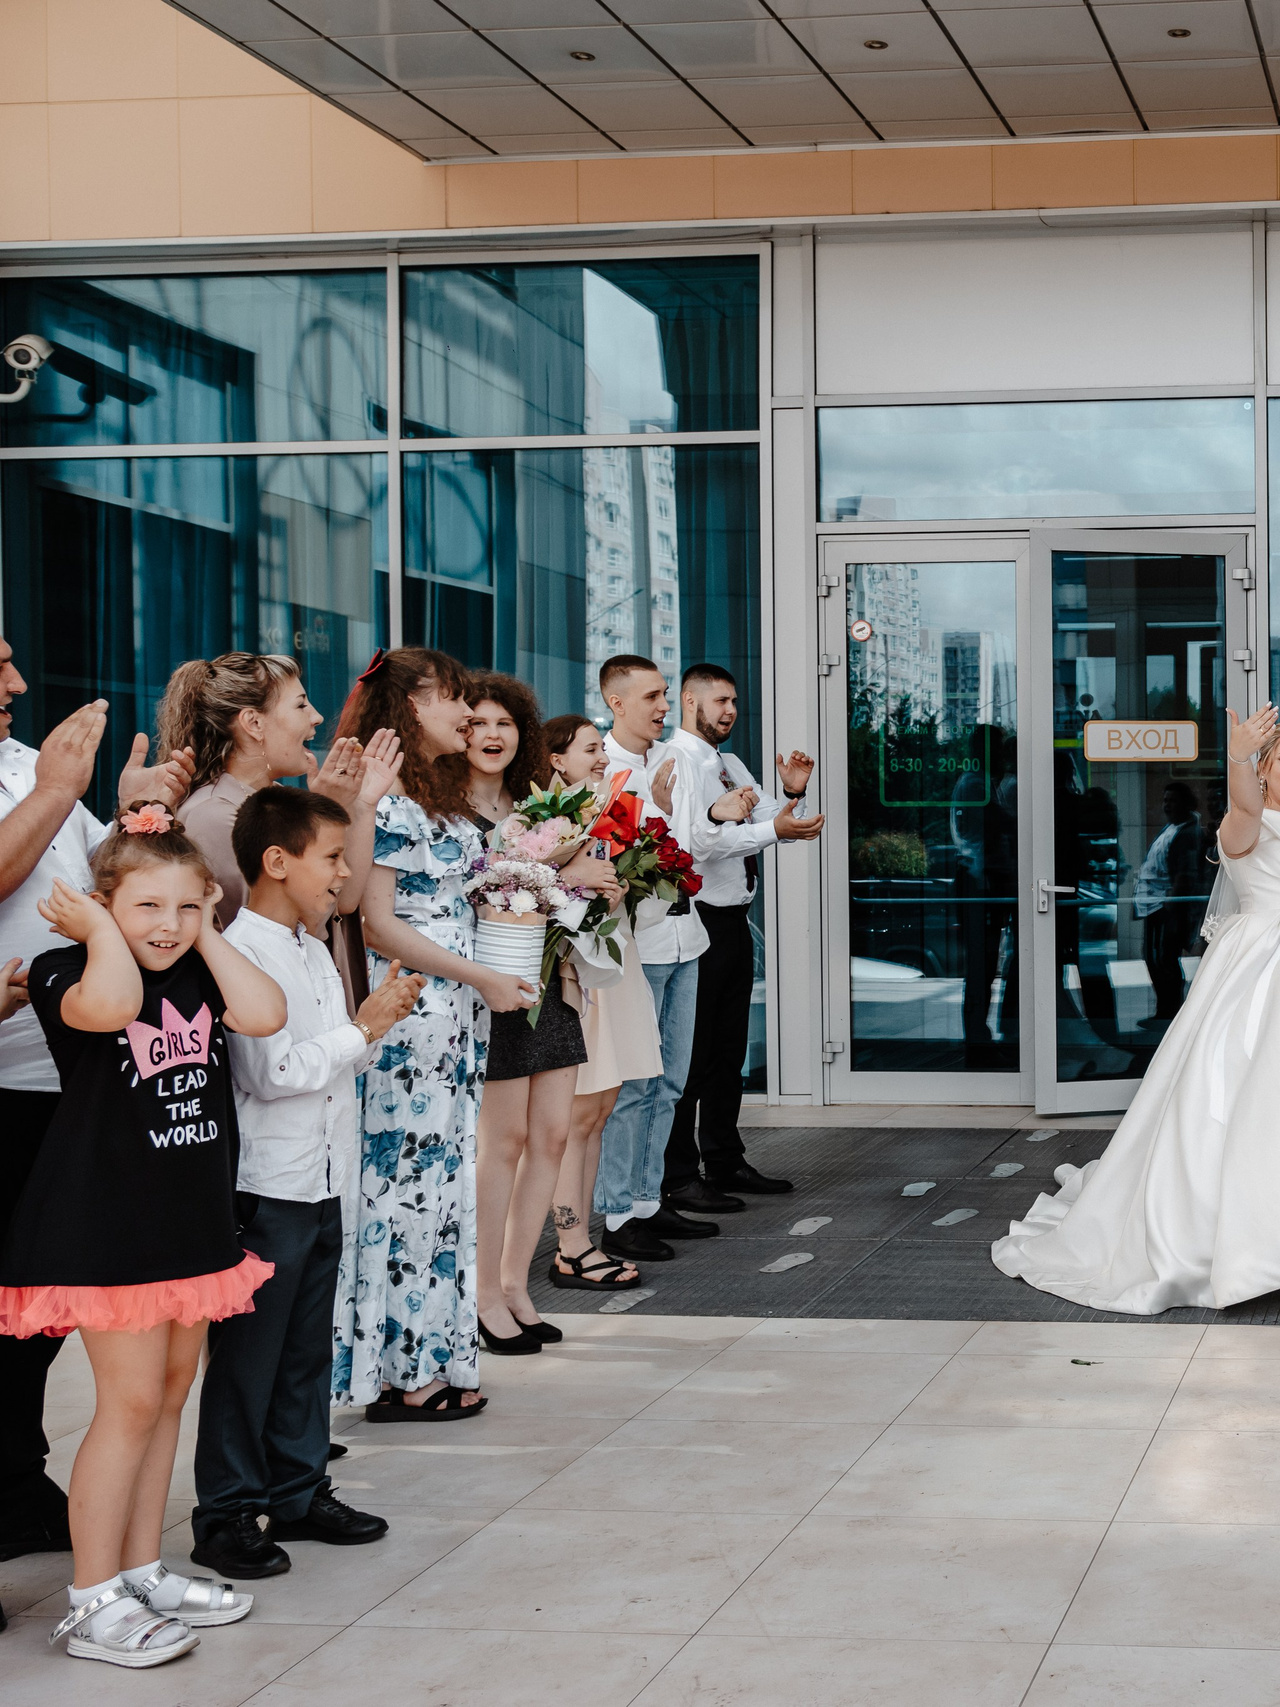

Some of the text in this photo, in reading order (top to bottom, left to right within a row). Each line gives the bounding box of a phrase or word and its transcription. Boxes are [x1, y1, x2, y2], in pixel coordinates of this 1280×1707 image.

[1107, 729, 1180, 754] ВХОД
[890, 757, 923, 773] 8-30
[938, 757, 980, 773] 20-00
[158, 1069, 207, 1096] LEAD
[166, 1098, 202, 1121] THE
[149, 1120, 218, 1148] WORLD
